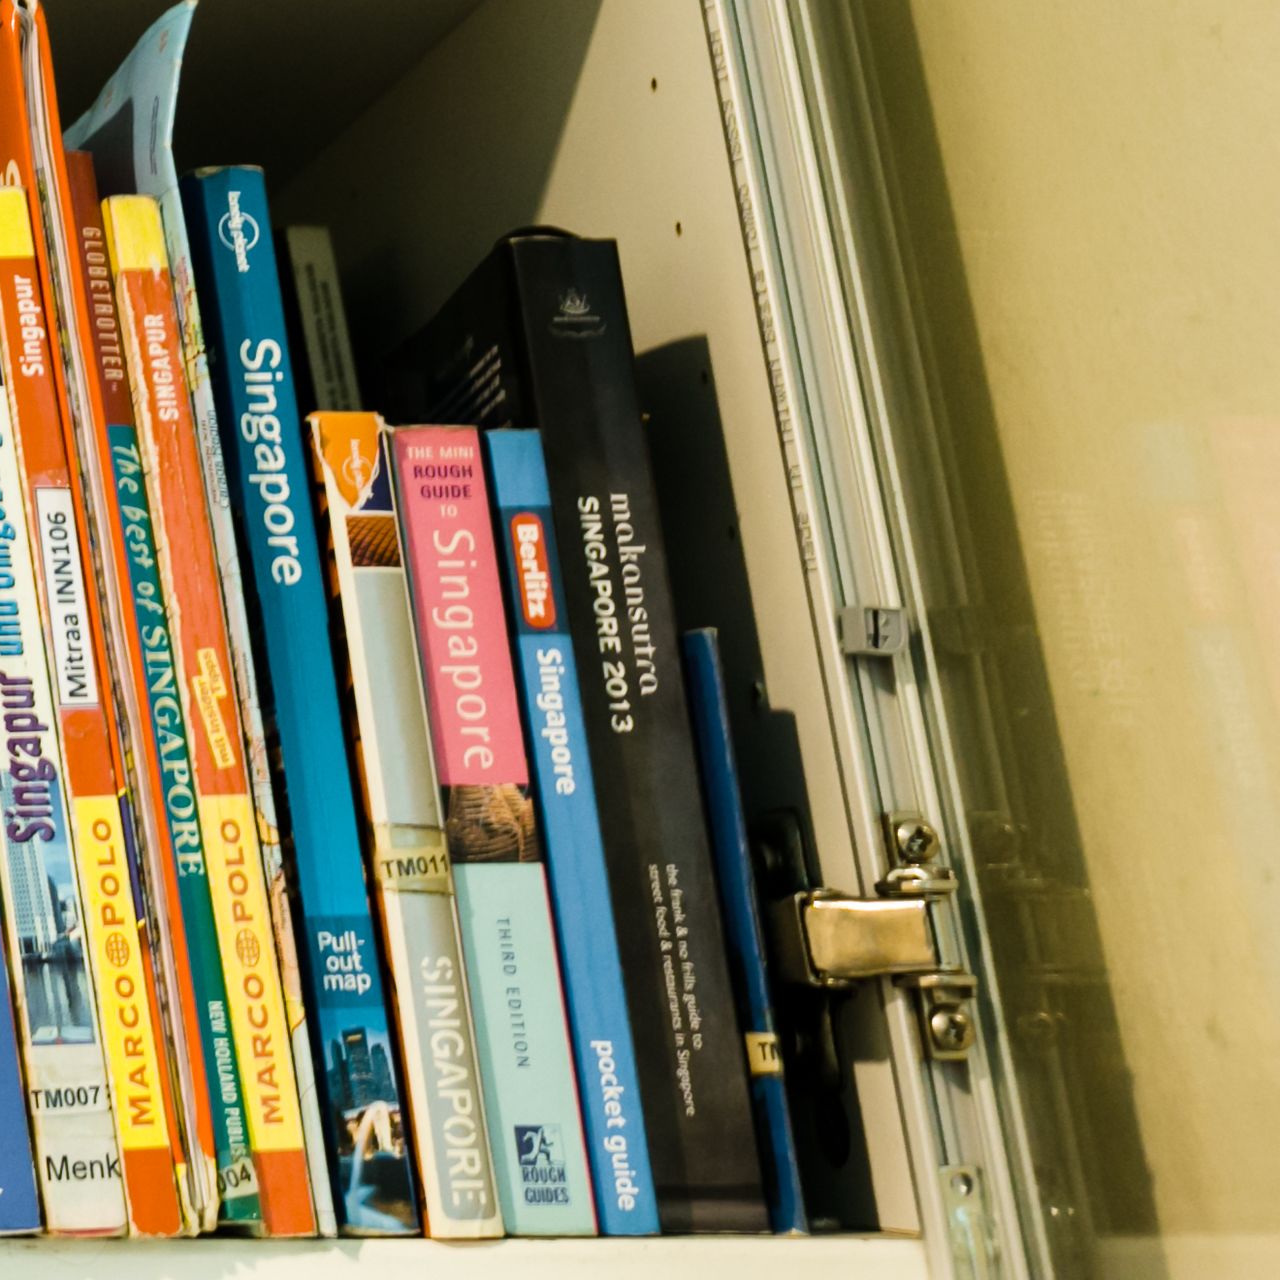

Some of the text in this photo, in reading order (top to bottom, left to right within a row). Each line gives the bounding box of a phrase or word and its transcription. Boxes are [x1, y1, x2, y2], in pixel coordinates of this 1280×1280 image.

[17, 275, 46, 378] Singapur
[143, 313, 180, 422] SINGAPUR
[239, 337, 303, 586] Singapore
[413, 464, 474, 480] ROUGH
[420, 484, 472, 500] GUIDE
[46, 511, 89, 699] Mitraa INN106
[514, 523, 547, 620] Berlitz
[577, 496, 634, 734] SINGAPORE 2013
[609, 491, 658, 697] makansutra
[433, 529, 496, 771] Singapore
[536, 649, 575, 795] Singapore
[89, 817, 155, 1130] MARCO POLO
[220, 818, 285, 1126] MARCO POLO
[323, 973, 372, 995] map
[325, 956, 363, 973] out
[46, 1154, 121, 1182] Menk
[589, 1039, 637, 1213] pocket guide
[525, 1186, 570, 1205] GUIDES
